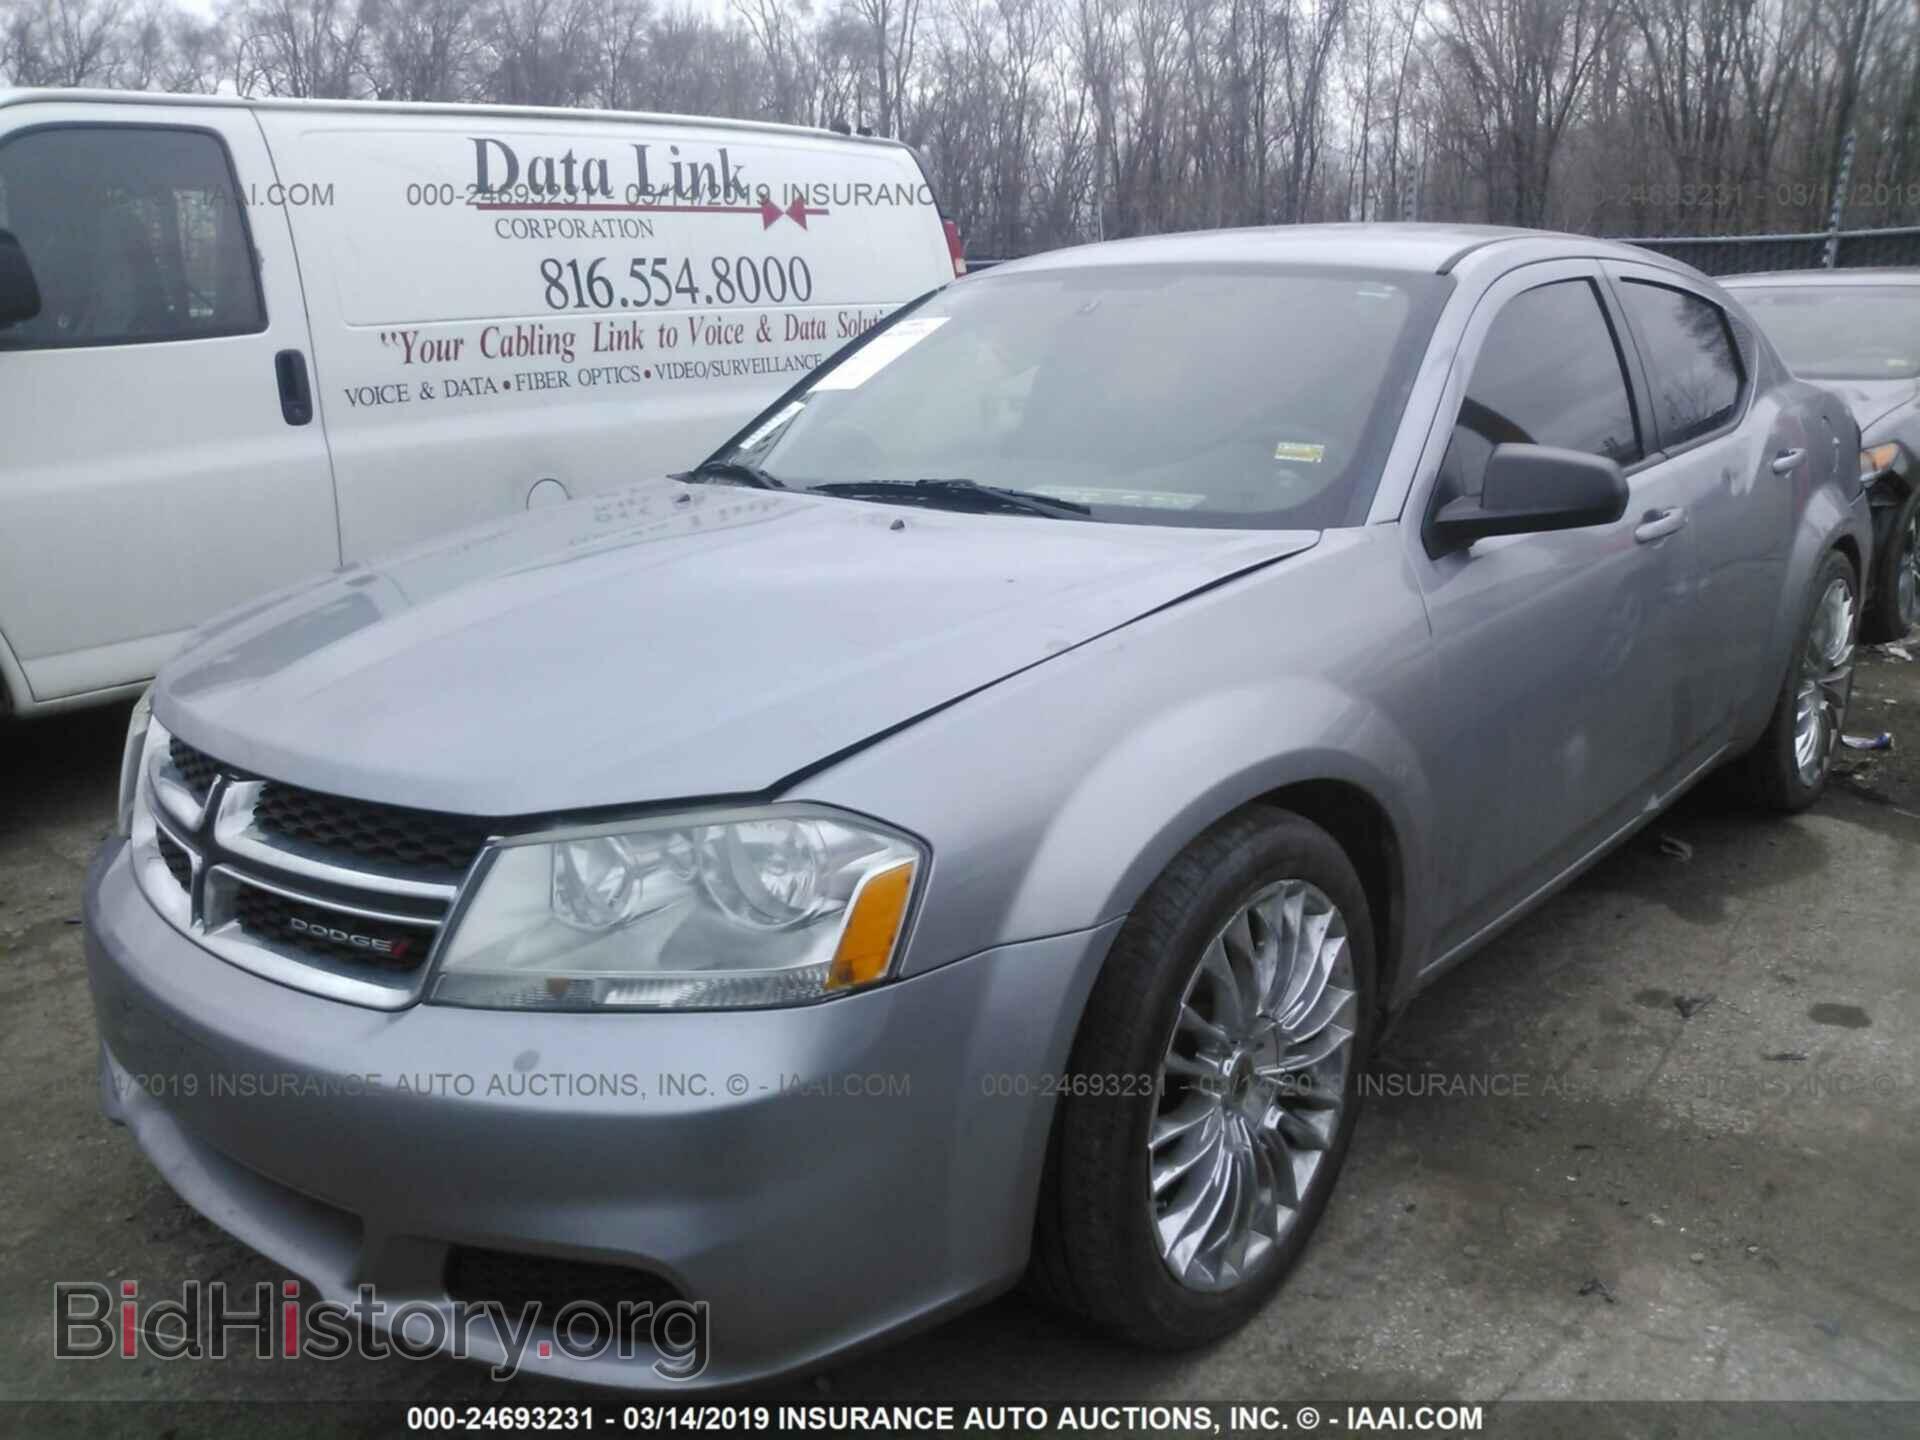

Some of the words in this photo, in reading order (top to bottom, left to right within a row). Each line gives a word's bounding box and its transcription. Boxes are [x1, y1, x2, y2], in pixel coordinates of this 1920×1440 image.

[467, 138, 613, 197] Data
[630, 144, 748, 198] Link
[495, 217, 655, 239] CORPORATION
[540, 255, 813, 310] 816.554.8000
[480, 323, 576, 363] Cabling
[592, 319, 645, 353] Link
[657, 323, 679, 349] to
[688, 315, 744, 347] Voice
[756, 312, 772, 343] &
[784, 312, 827, 342] Data
[344, 382, 410, 407] VOICE
[419, 381, 435, 401] &
[444, 377, 499, 399] DATA
[515, 370, 572, 392] FIBER
[577, 364, 641, 387] OPTICS
[654, 353, 823, 381] VIDEO/SURVEILLANCE
[290, 917, 393, 953] DODGE
